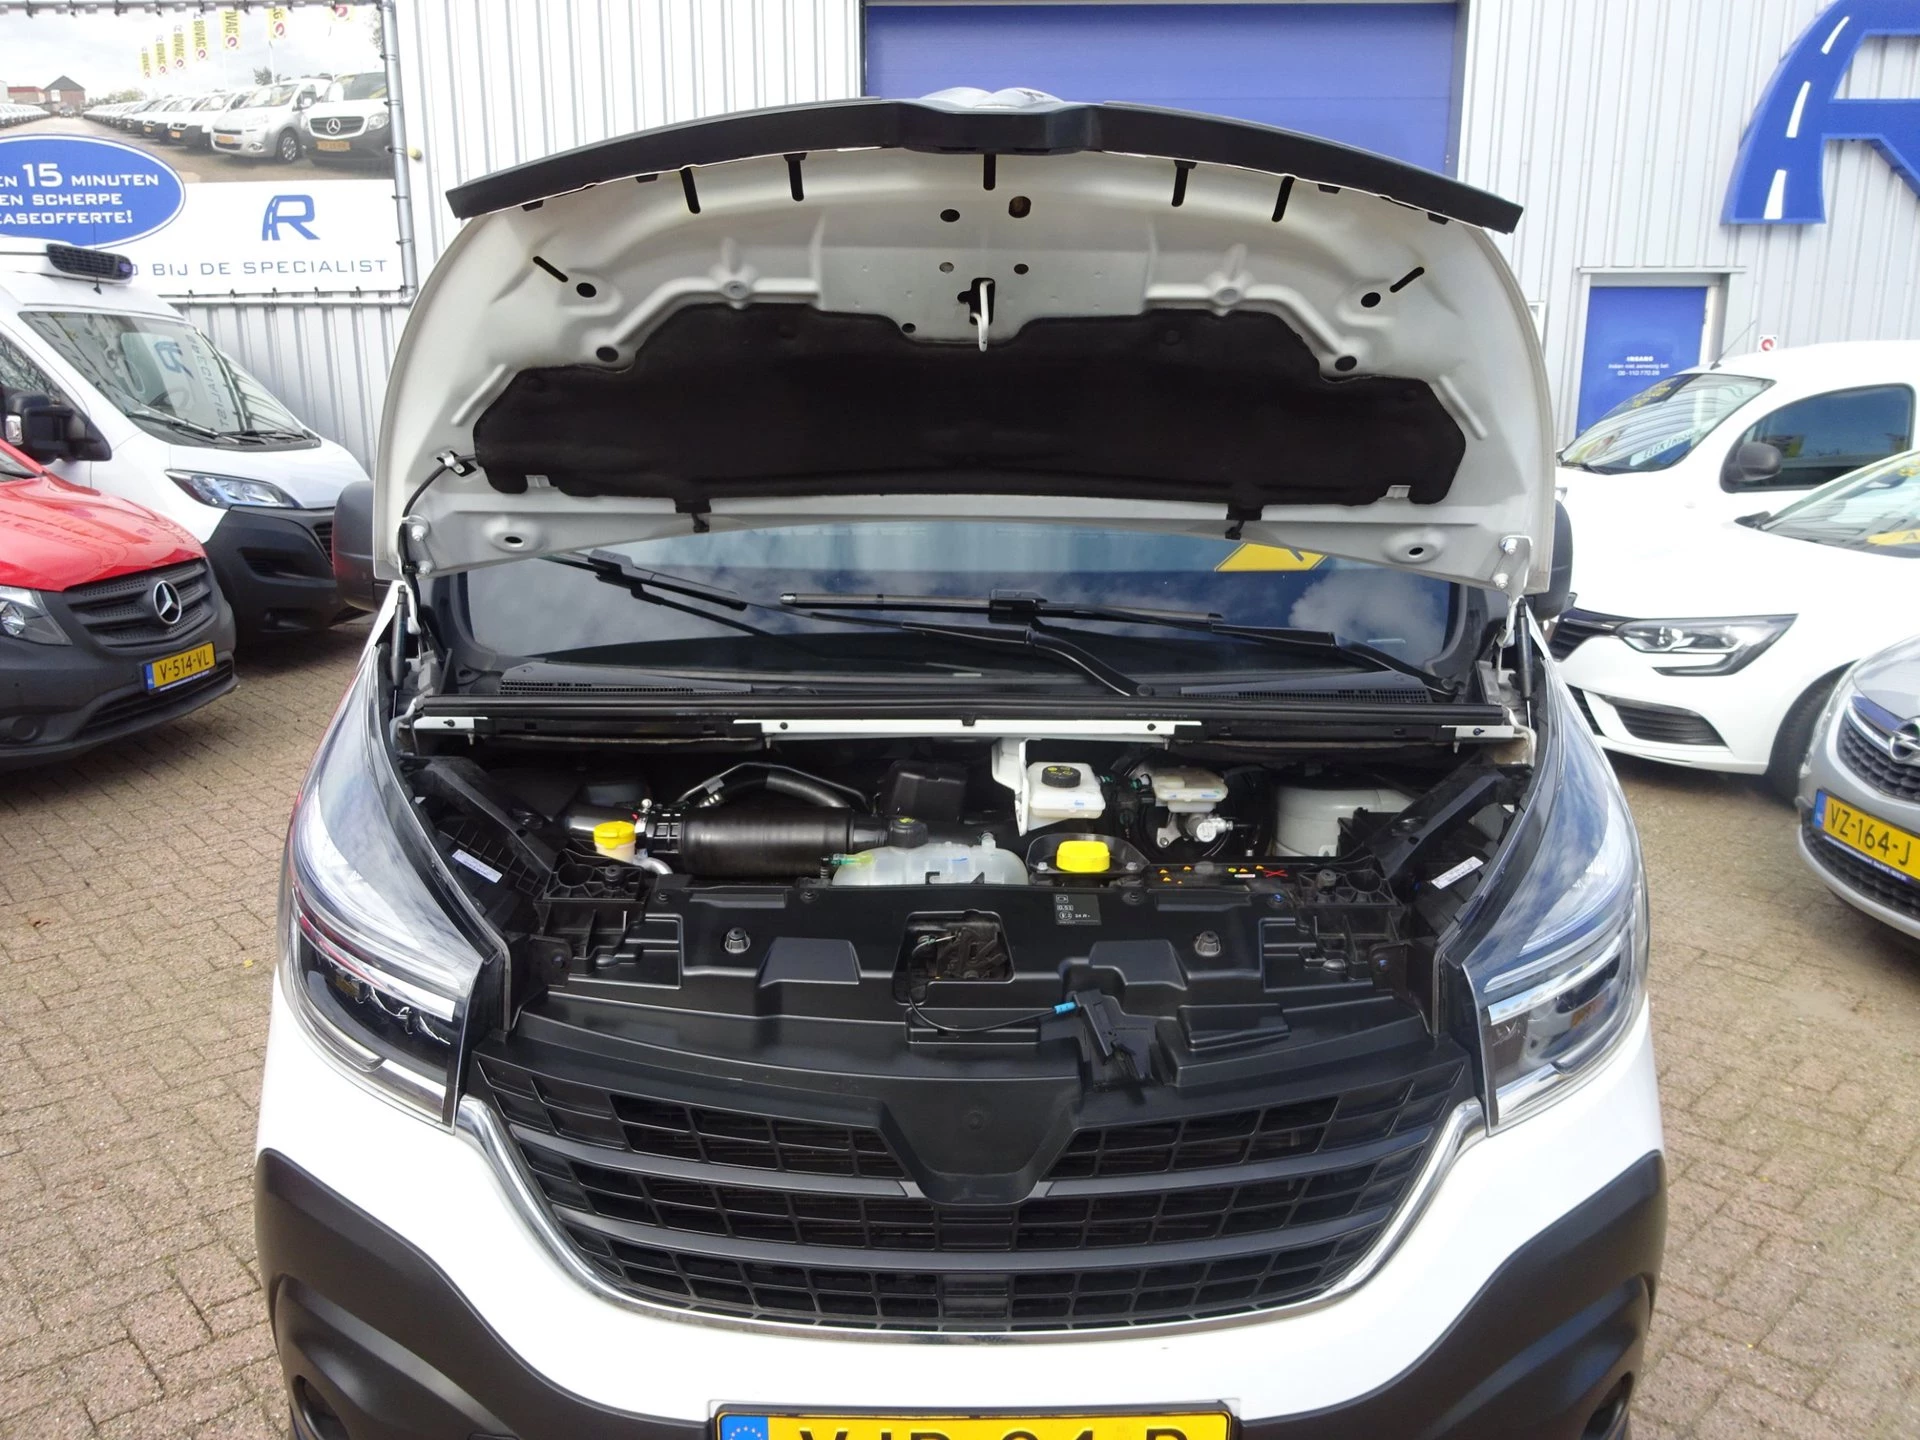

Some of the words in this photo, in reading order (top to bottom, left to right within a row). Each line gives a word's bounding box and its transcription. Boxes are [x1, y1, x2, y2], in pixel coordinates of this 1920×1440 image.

[193, 20, 206, 48] BOVAG
[22, 163, 63, 188] 15
[71, 174, 160, 187] MINUTEN
[32, 193, 123, 206] SCHERPE
[0, 210, 134, 225] ASEOFFERTE!
[152, 263, 189, 276] BIJ
[200, 262, 231, 276] DE
[243, 260, 389, 275] SPECIALIST
[159, 649, 210, 681] V-514-VL
[1831, 803, 1912, 866] VZ-164-J
